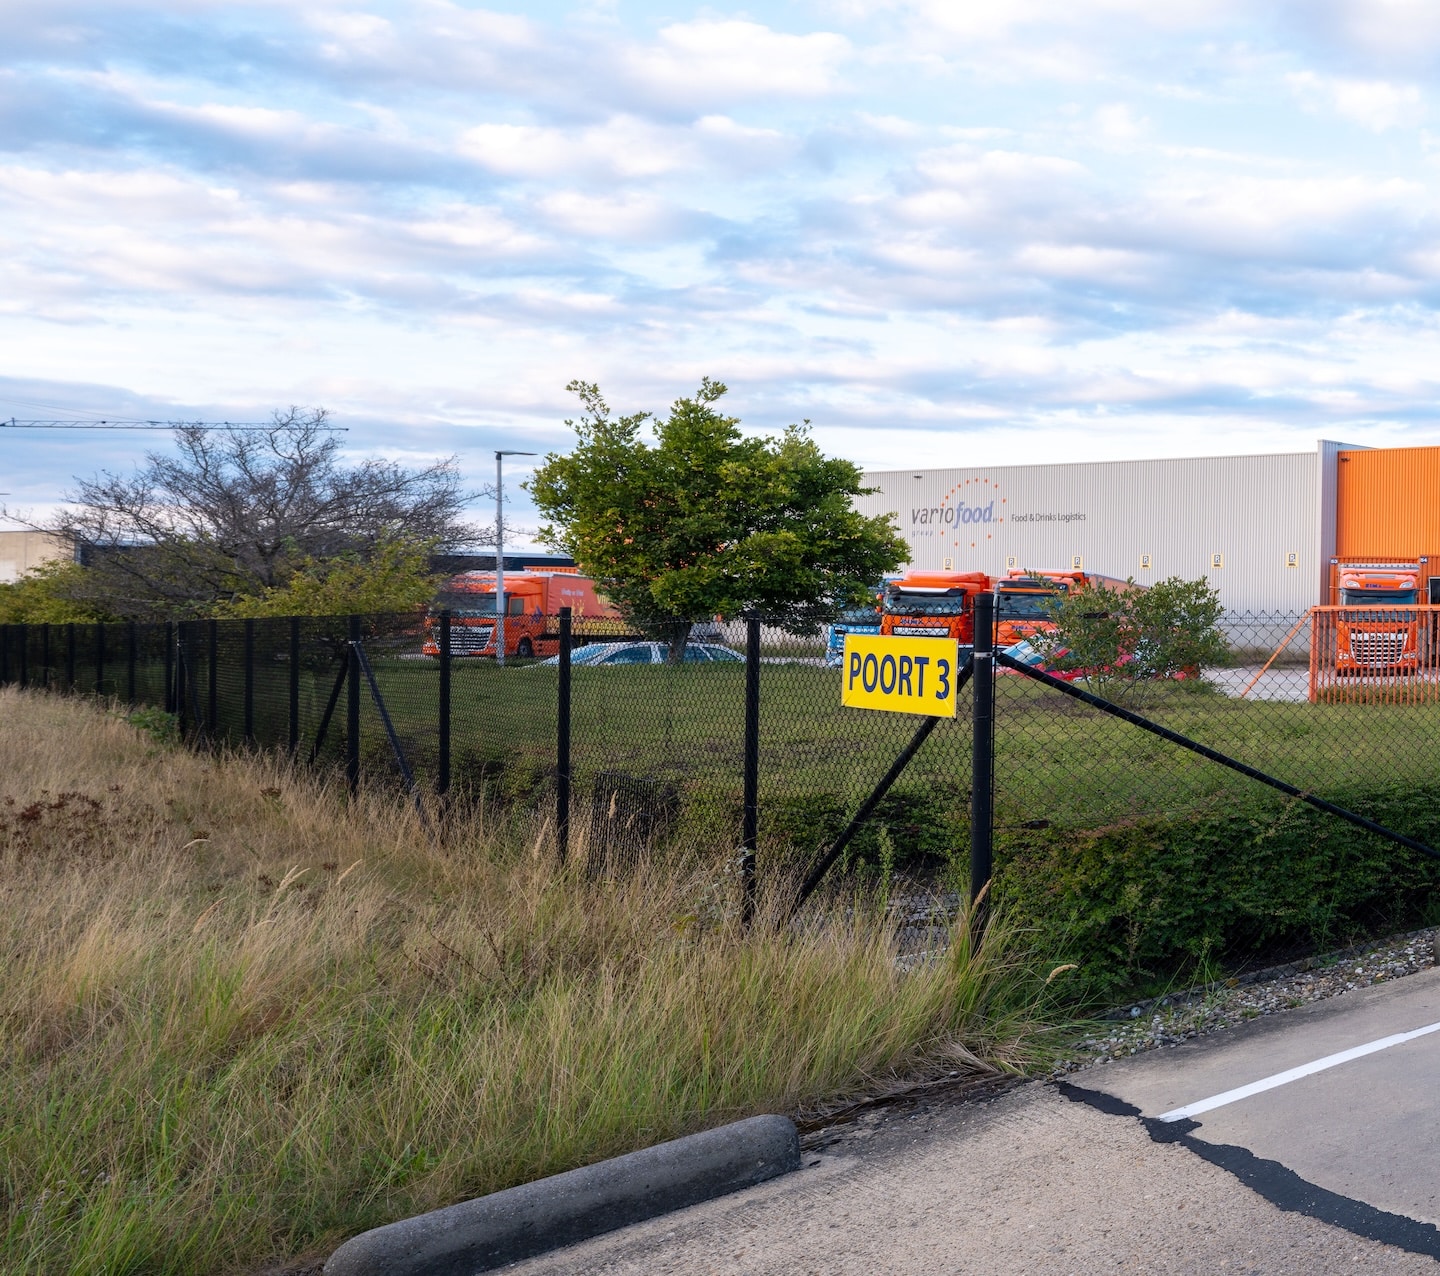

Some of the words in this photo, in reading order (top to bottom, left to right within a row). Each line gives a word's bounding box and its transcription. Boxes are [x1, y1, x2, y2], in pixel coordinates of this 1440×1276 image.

[1011, 513, 1028, 522] Food
[1029, 513, 1035, 522] &
[1035, 512, 1057, 522] Drinks
[1057, 511, 1087, 524] Logistics
[848, 652, 930, 697] POORT
[935, 659, 950, 700] 3
